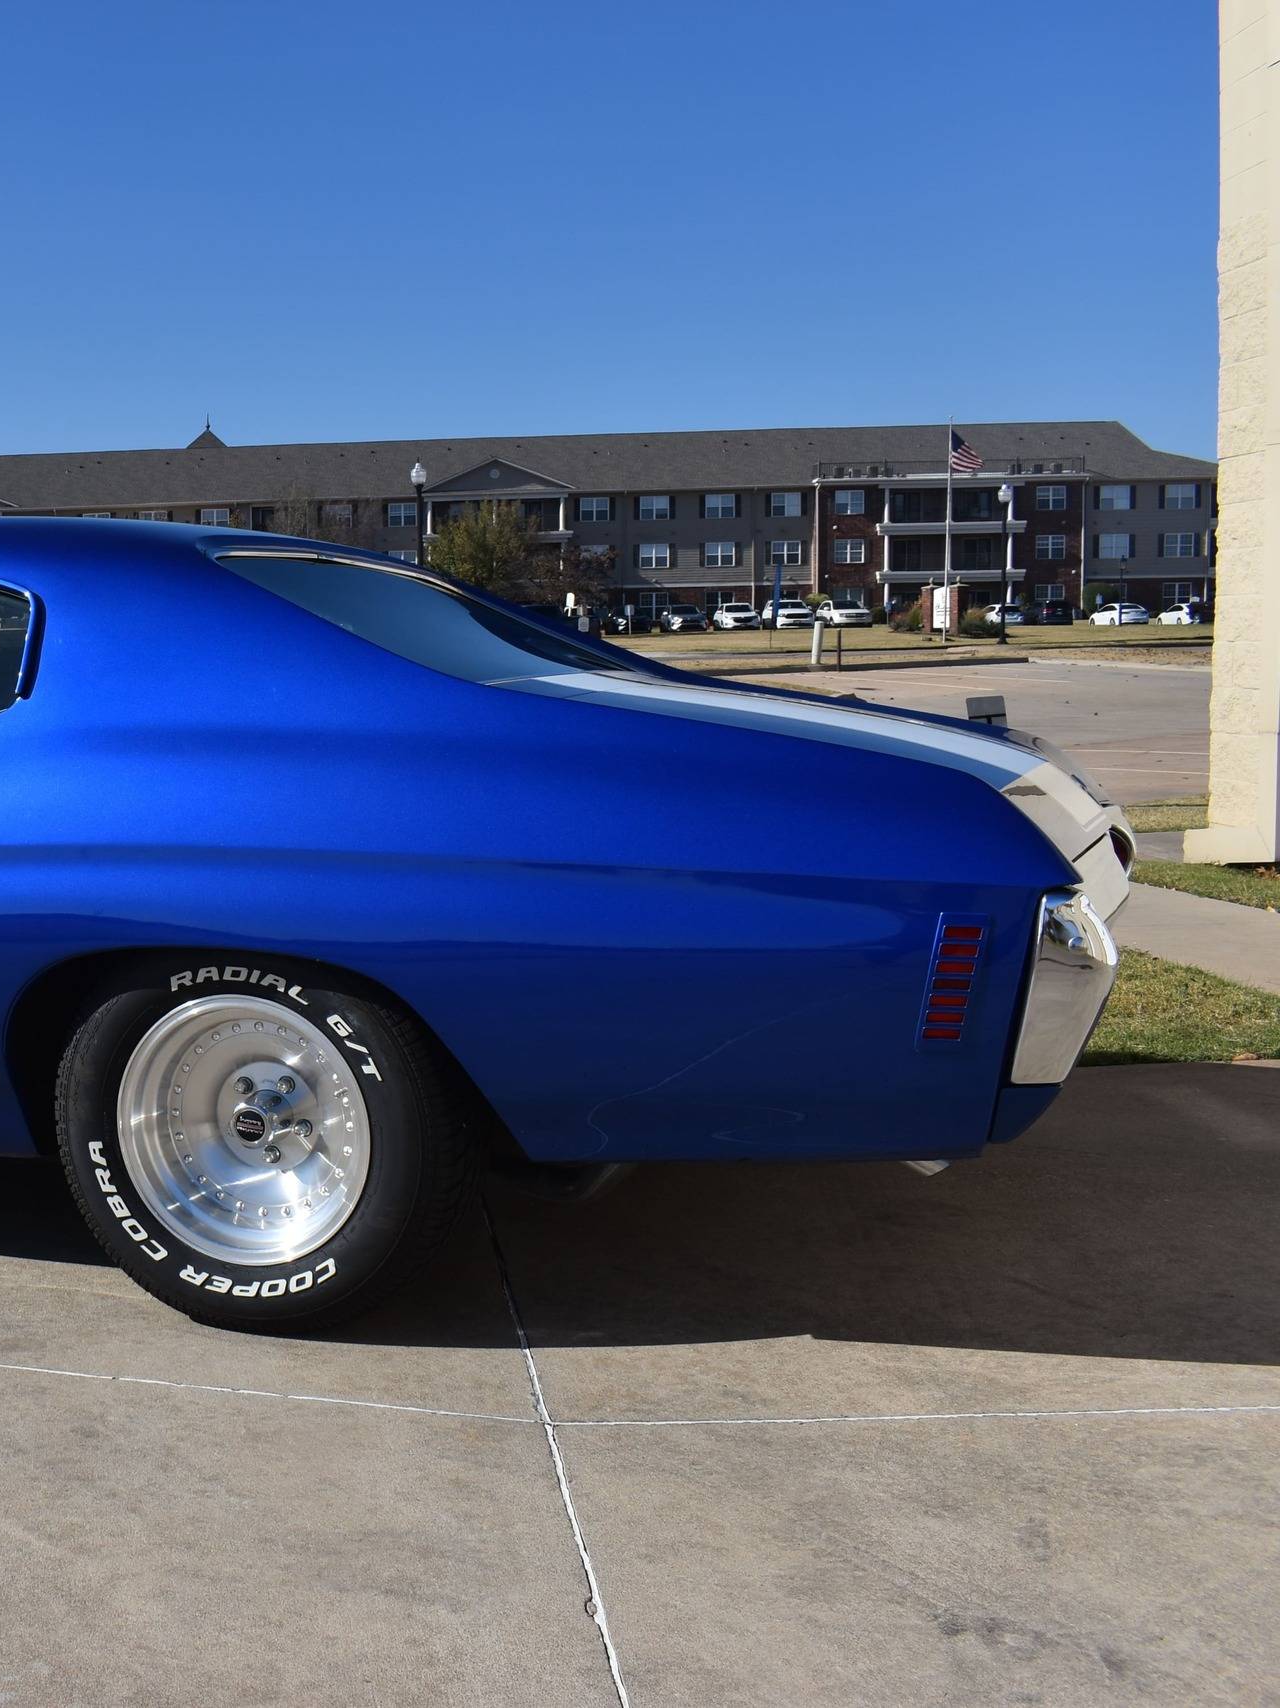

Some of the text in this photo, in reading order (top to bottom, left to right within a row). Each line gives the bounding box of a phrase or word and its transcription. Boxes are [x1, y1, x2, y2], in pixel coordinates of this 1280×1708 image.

[170, 966, 383, 1082] RADIAL G/T
[88, 1141, 337, 1298] COOPER COBRA
